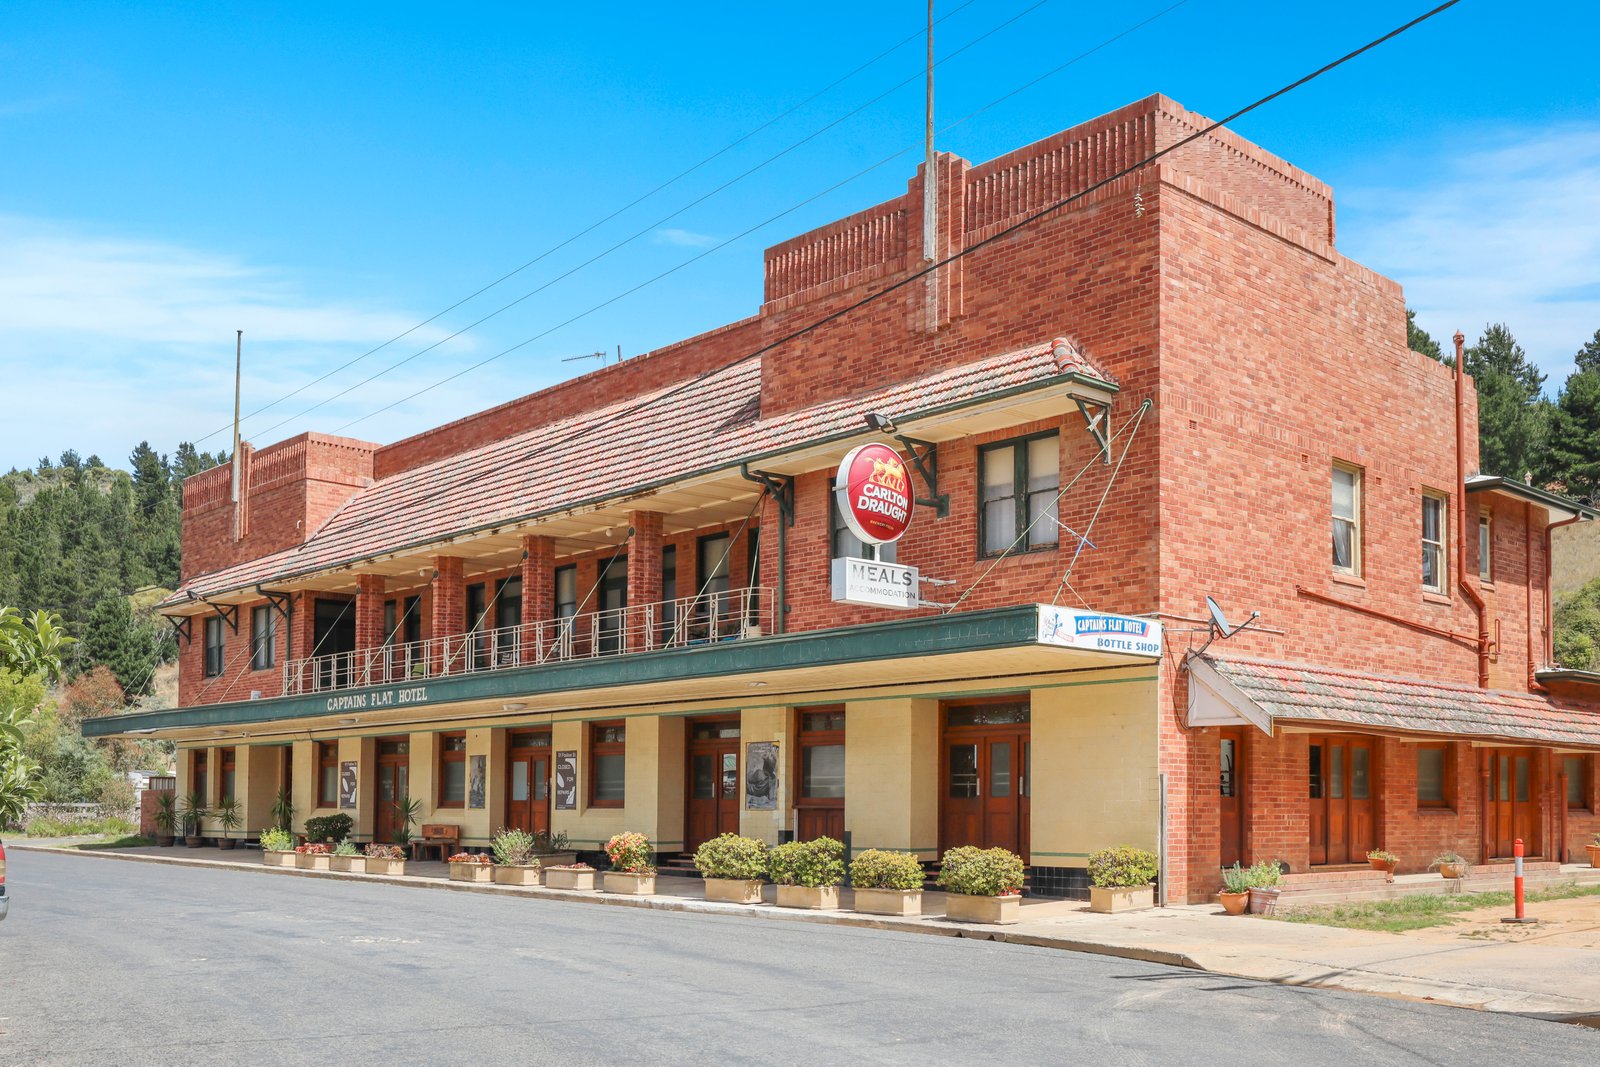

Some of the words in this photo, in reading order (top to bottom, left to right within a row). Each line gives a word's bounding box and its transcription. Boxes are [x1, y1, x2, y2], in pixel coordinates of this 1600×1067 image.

[863, 483, 909, 511] CARLTON
[857, 495, 907, 524] DRAUGHT
[853, 564, 912, 586] MEALS
[850, 584, 916, 599] ACCOMMODATION
[1077, 619, 1106, 632] CAPTAINS
[1108, 620, 1123, 631] FLAT
[1124, 621, 1143, 634] HOTEL
[1097, 638, 1132, 650] BOTTLE
[1136, 642, 1159, 652] SHOP
[327, 694, 366, 711] CAPTAINS
[371, 691, 393, 706] FLAT
[399, 687, 427, 703] HOTEL
